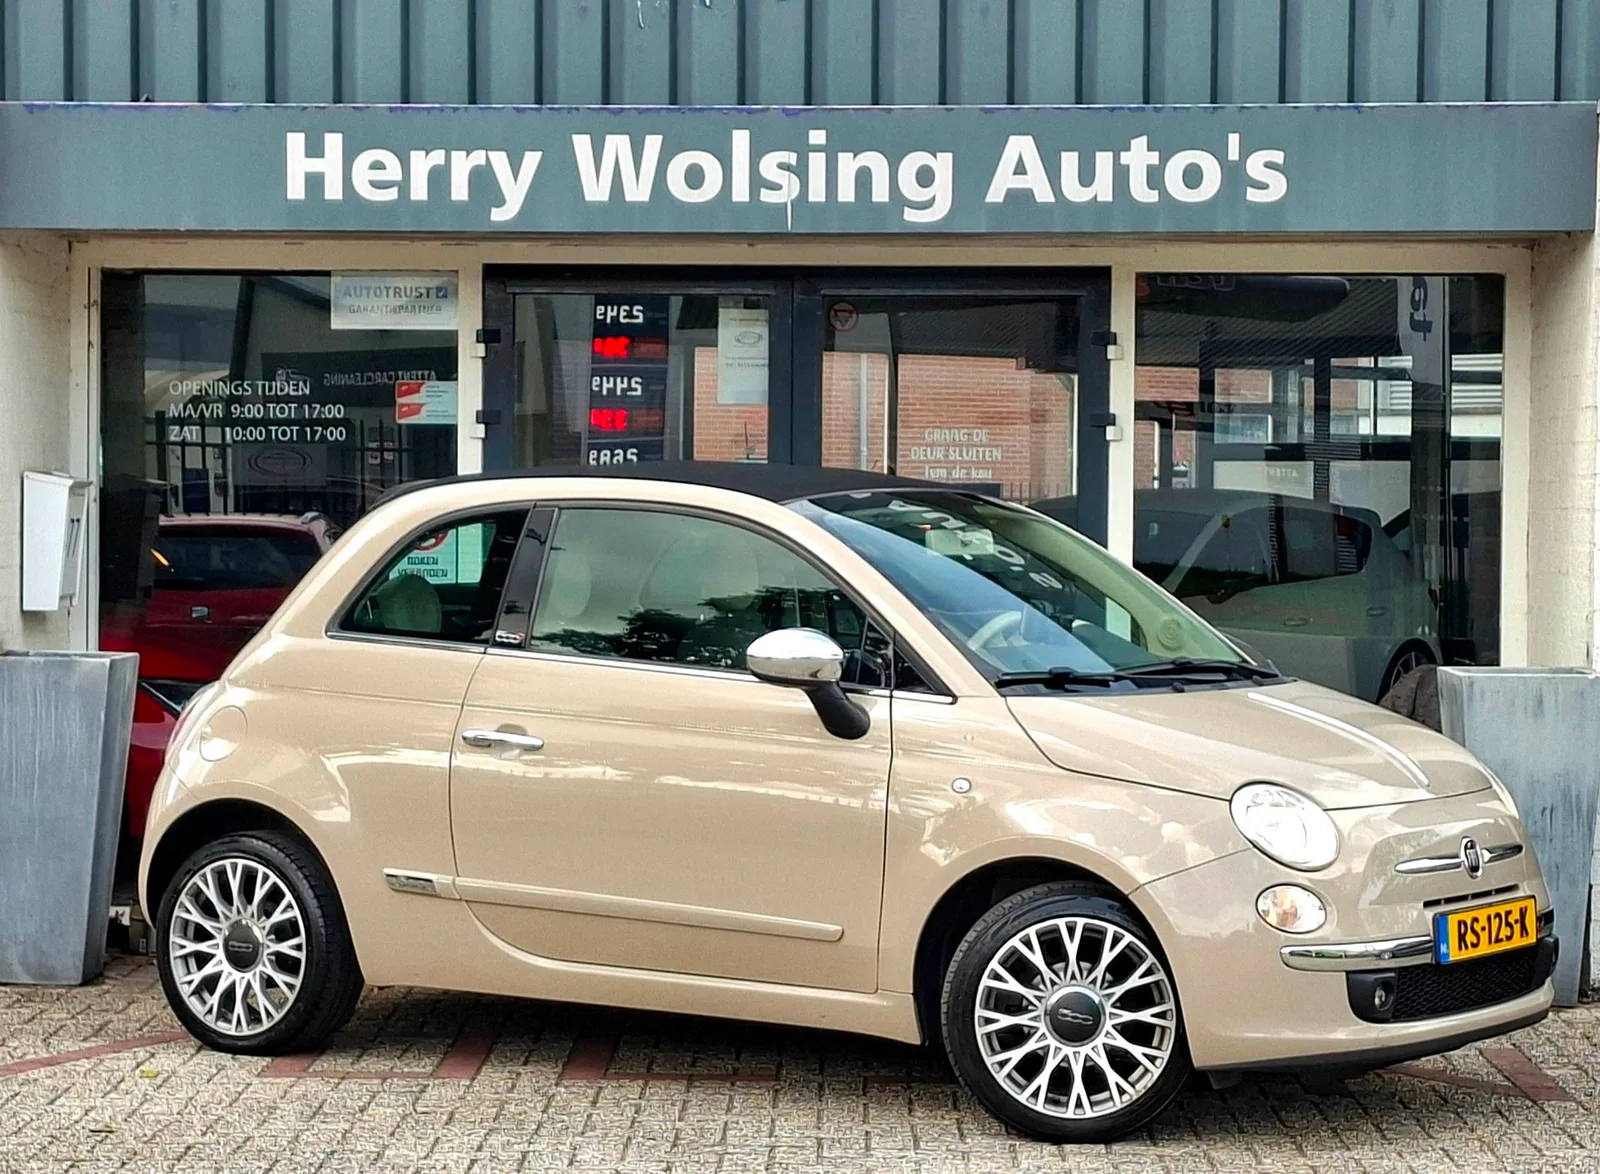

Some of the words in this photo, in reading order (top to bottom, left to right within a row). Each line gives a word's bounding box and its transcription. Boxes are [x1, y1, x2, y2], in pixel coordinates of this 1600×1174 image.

[285, 130, 543, 222] Herry
[571, 128, 954, 223] Wolsing
[984, 131, 1288, 204] Auto's
[343, 285, 434, 299] AUTOTRUST
[168, 380, 252, 396] OPENINGS
[168, 403, 223, 419] MA/VR
[231, 403, 264, 419] 9:00
[266, 403, 298, 419] TOT
[303, 403, 345, 419] 17:00
[168, 425, 201, 441] ZAT
[225, 425, 266, 441] 10:00
[267, 425, 300, 441] TOT
[304, 425, 347, 441] 17:00
[924, 428, 969, 442] GRAAG
[911, 446, 945, 461] DEUR
[948, 446, 1002, 462] SLUITEN
[1457, 905, 1530, 952] RS-125-K
